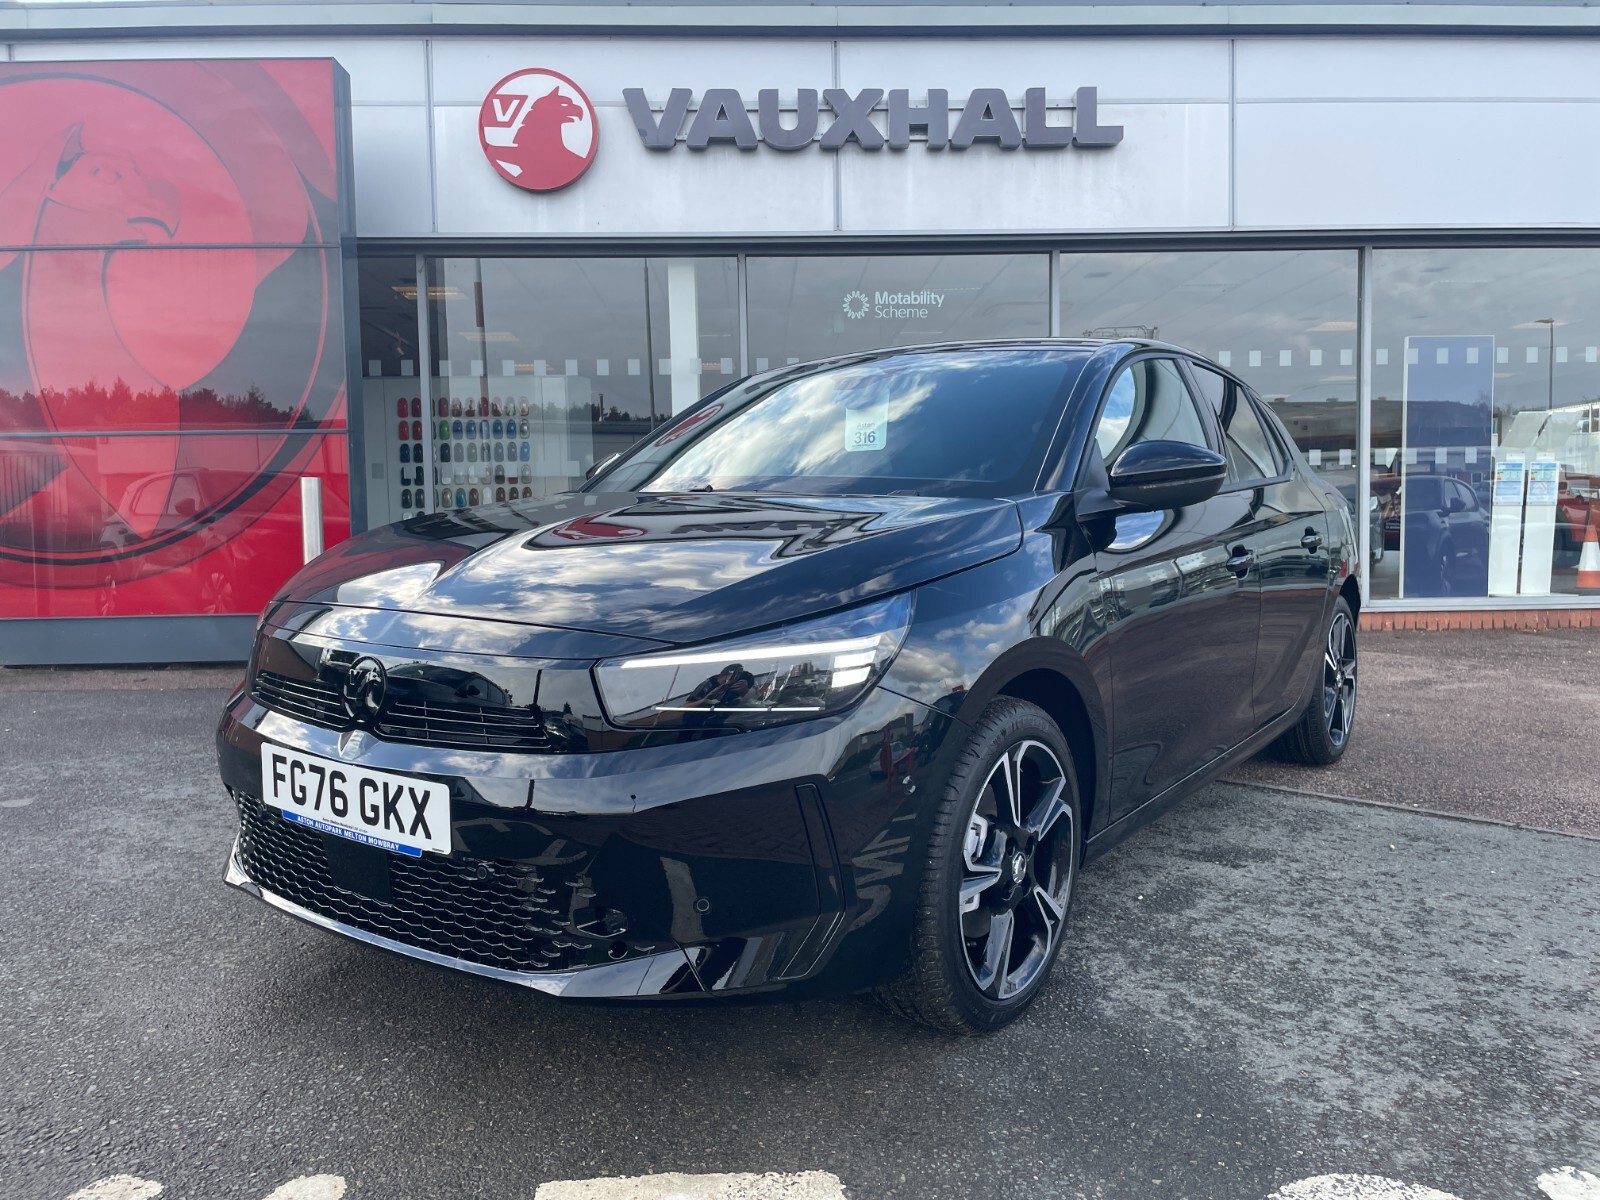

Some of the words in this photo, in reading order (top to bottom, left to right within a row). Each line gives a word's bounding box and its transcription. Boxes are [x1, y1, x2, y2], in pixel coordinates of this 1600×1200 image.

[492, 98, 520, 122] V
[622, 86, 1124, 151] VAUXHALL
[875, 291, 945, 308] Motability
[875, 305, 928, 318] Scheme
[854, 431, 876, 444] 316
[272, 753, 348, 818] FG76
[359, 777, 432, 840] GKX
[297, 816, 314, 826] ASTON
[315, 821, 342, 836] AUTOPARK
[344, 829, 367, 842] MELTON
[368, 836, 400, 850] MOWBRAY
